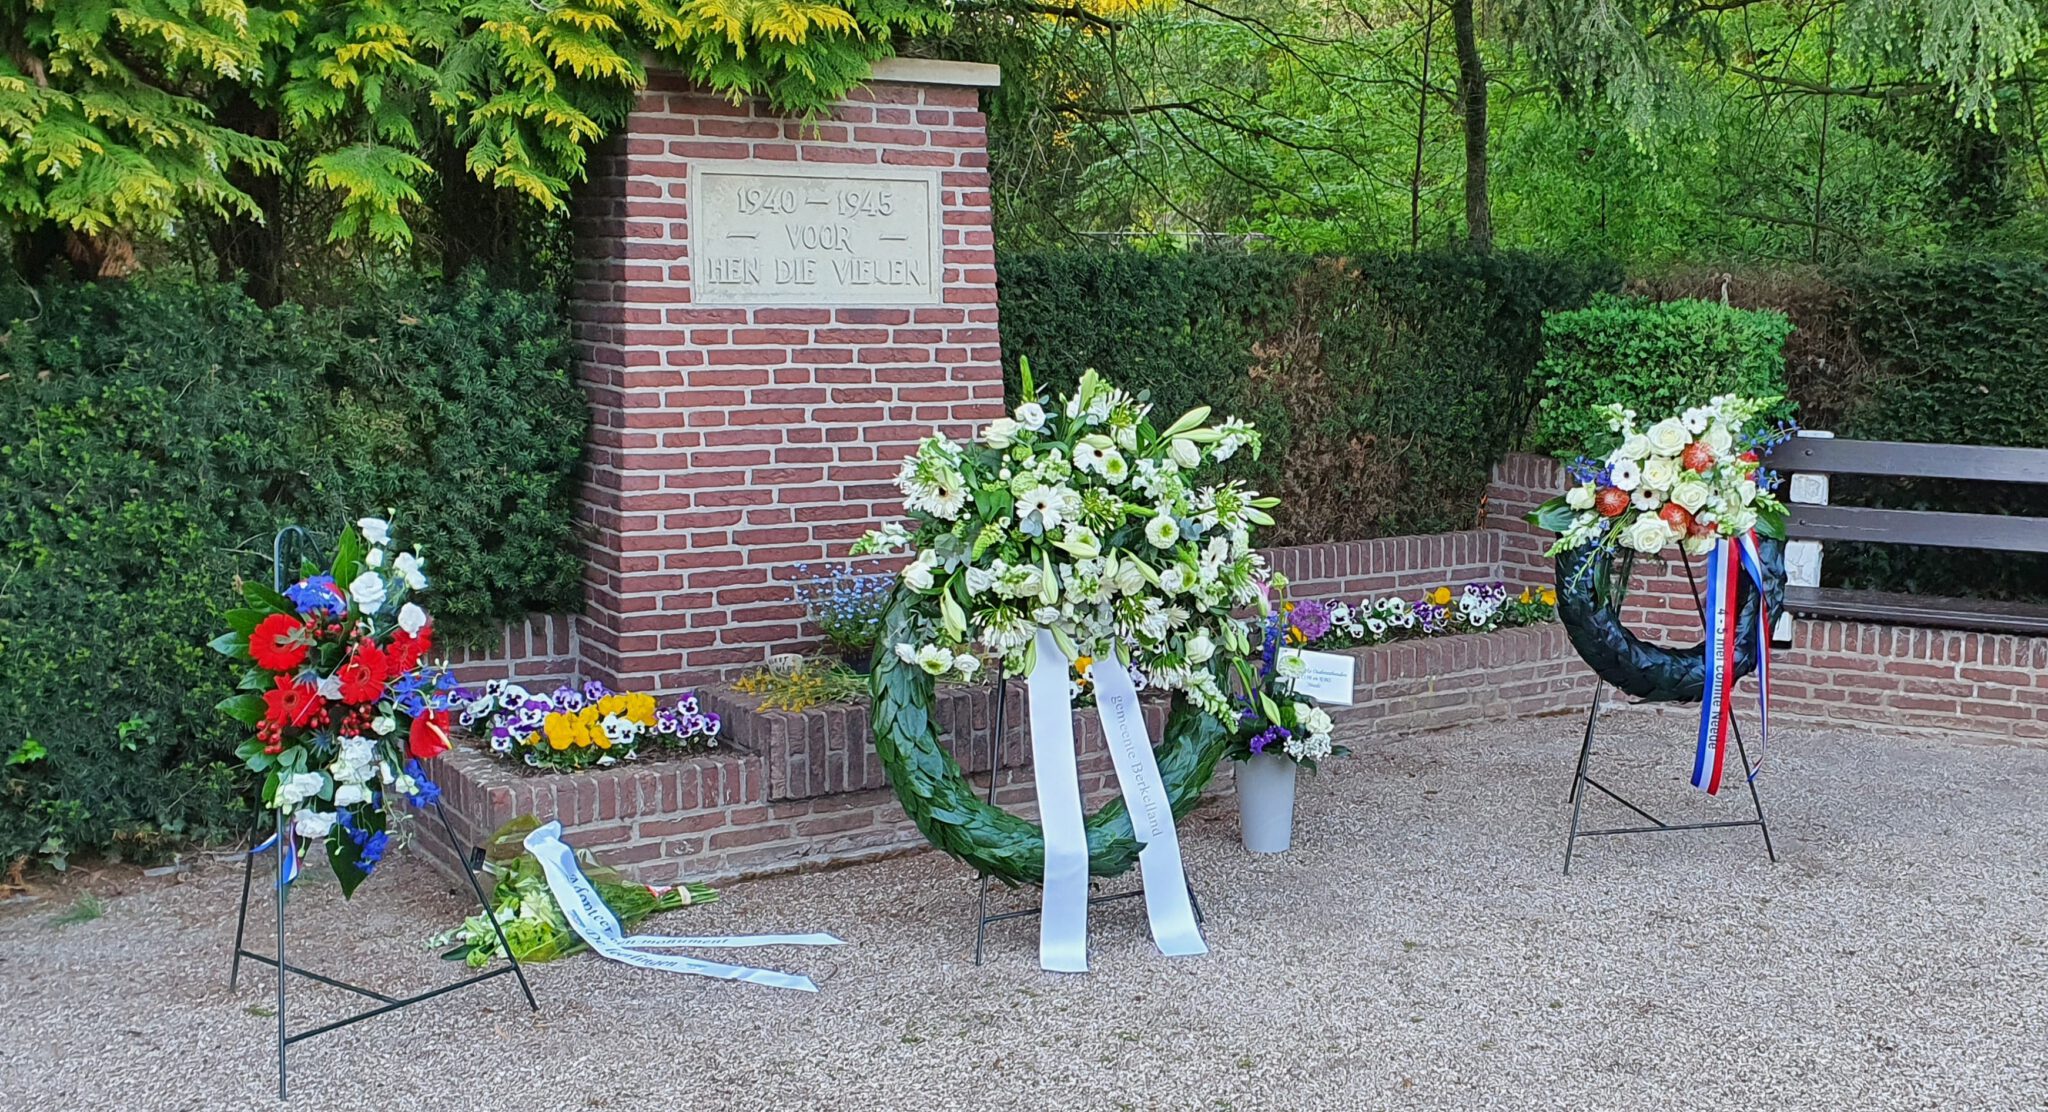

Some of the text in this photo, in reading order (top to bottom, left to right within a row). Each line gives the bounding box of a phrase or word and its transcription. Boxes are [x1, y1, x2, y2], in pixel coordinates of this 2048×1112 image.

[736, 185, 798, 216] 1940
[836, 188, 896, 218] 1945
[785, 223, 855, 254] VOOR
[707, 255, 762, 285] HEN
[774, 257, 818, 286] DIE
[1715, 638, 1727, 661] mei
[1707, 710, 1724, 750] Neede
[1110, 694, 1163, 838] gemeente Berkelland
[585, 927, 606, 946] De
